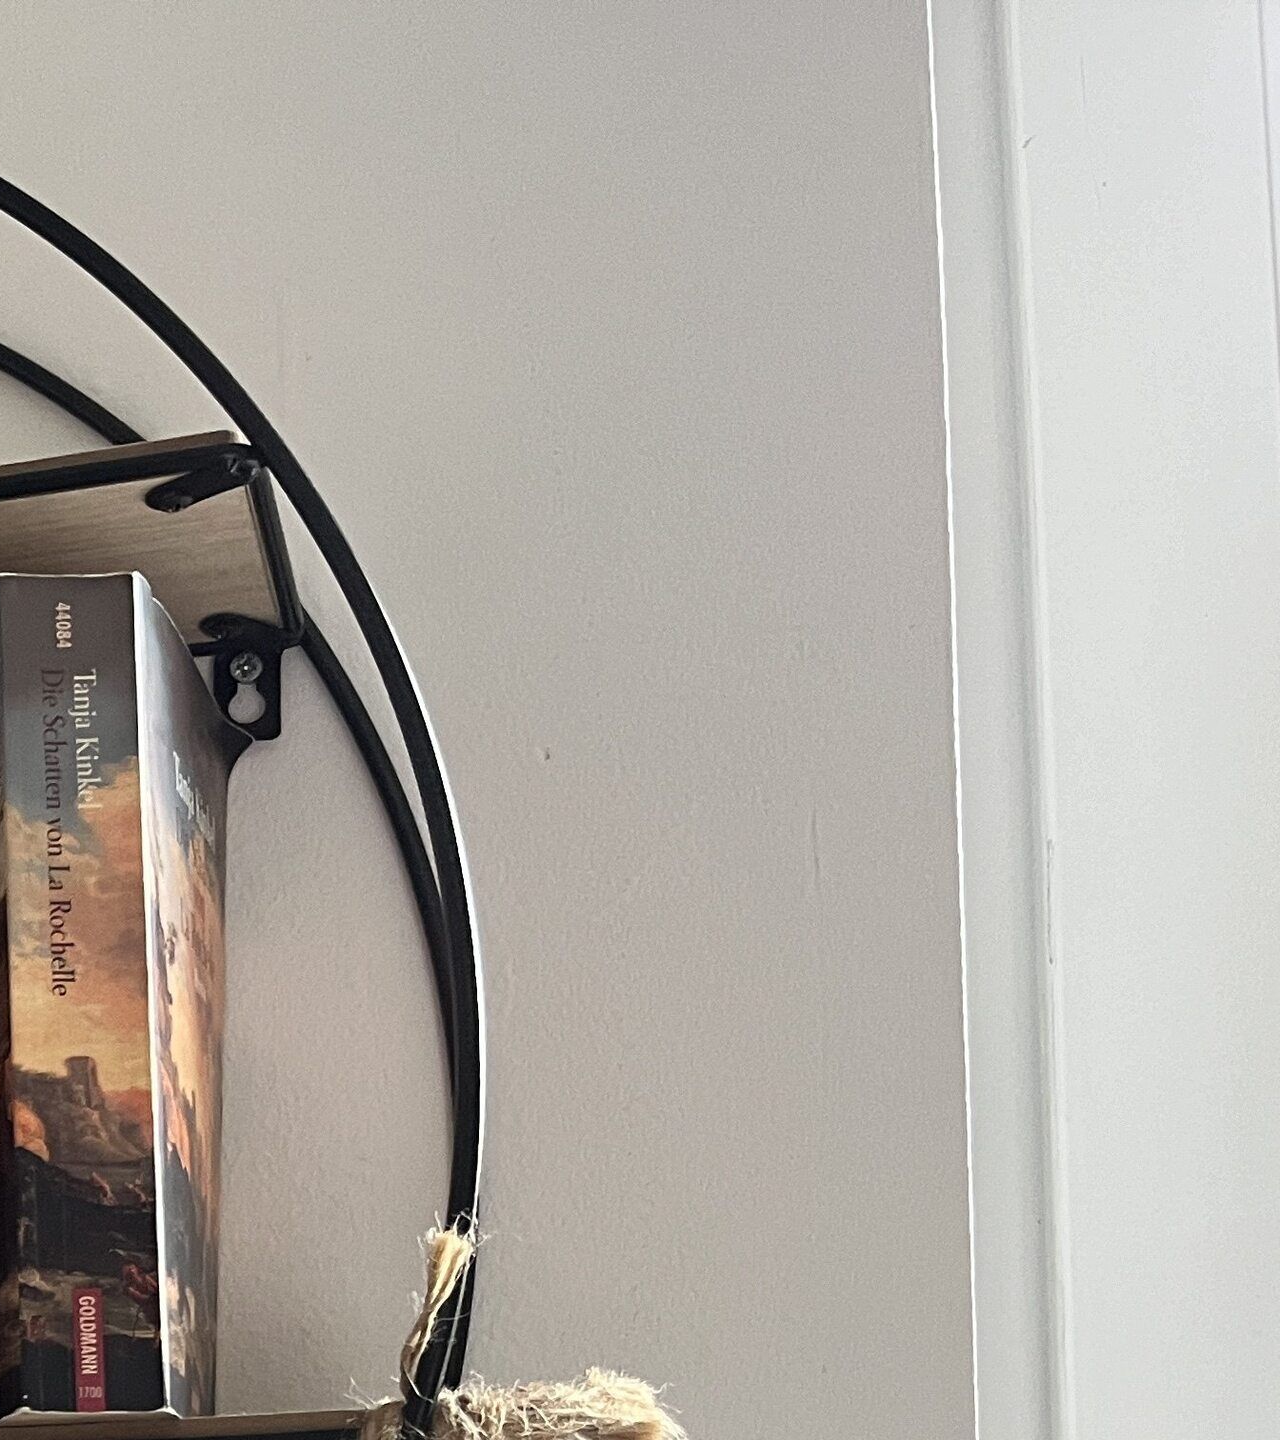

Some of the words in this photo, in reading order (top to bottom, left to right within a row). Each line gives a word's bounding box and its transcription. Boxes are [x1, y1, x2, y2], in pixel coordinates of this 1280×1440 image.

[55, 602, 72, 649] 44084
[41, 669, 65, 709] Die
[68, 669, 97, 730] Tanja
[42, 714, 68, 811] Schatten
[75, 737, 104, 810] Kinkel
[47, 817, 63, 857] von
[49, 866, 71, 891] La
[48, 899, 76, 997] Rochelle
[79, 1296, 99, 1375] GOLDMANN
